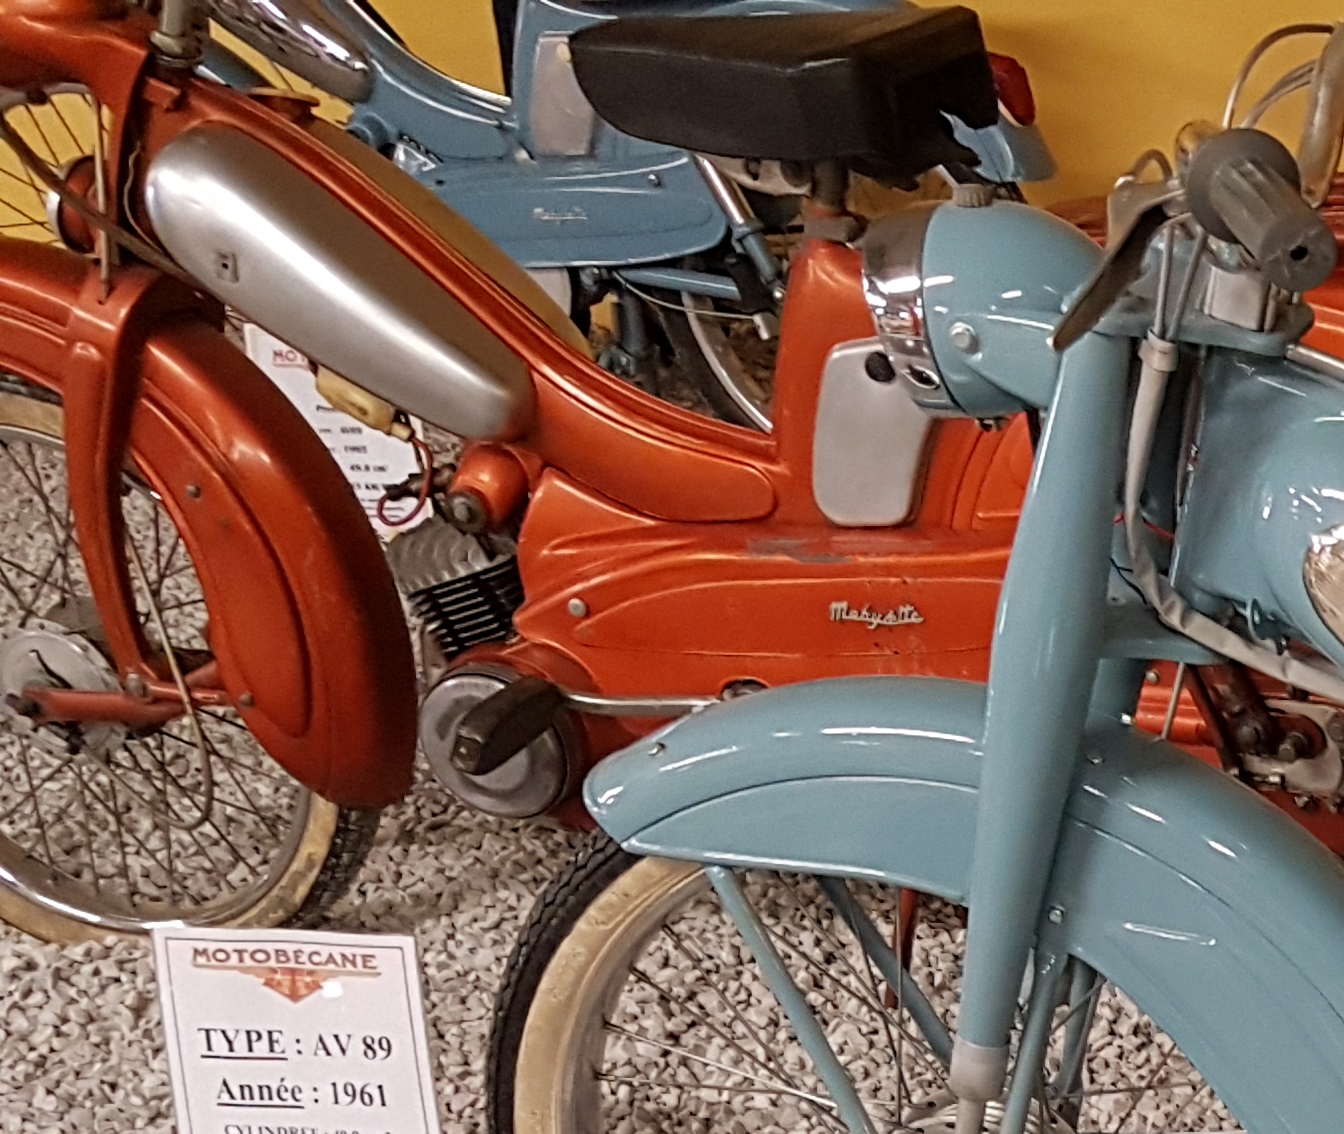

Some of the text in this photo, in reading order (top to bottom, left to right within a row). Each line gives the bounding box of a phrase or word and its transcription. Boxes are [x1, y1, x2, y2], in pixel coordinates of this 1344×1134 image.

[192, 947, 378, 970] MOTOBÉCANE
[198, 1027, 287, 1057] TYPE
[314, 1034, 351, 1057] AV
[361, 1035, 392, 1060] 89
[217, 1078, 304, 1104] Année
[331, 1081, 388, 1107] 1961
